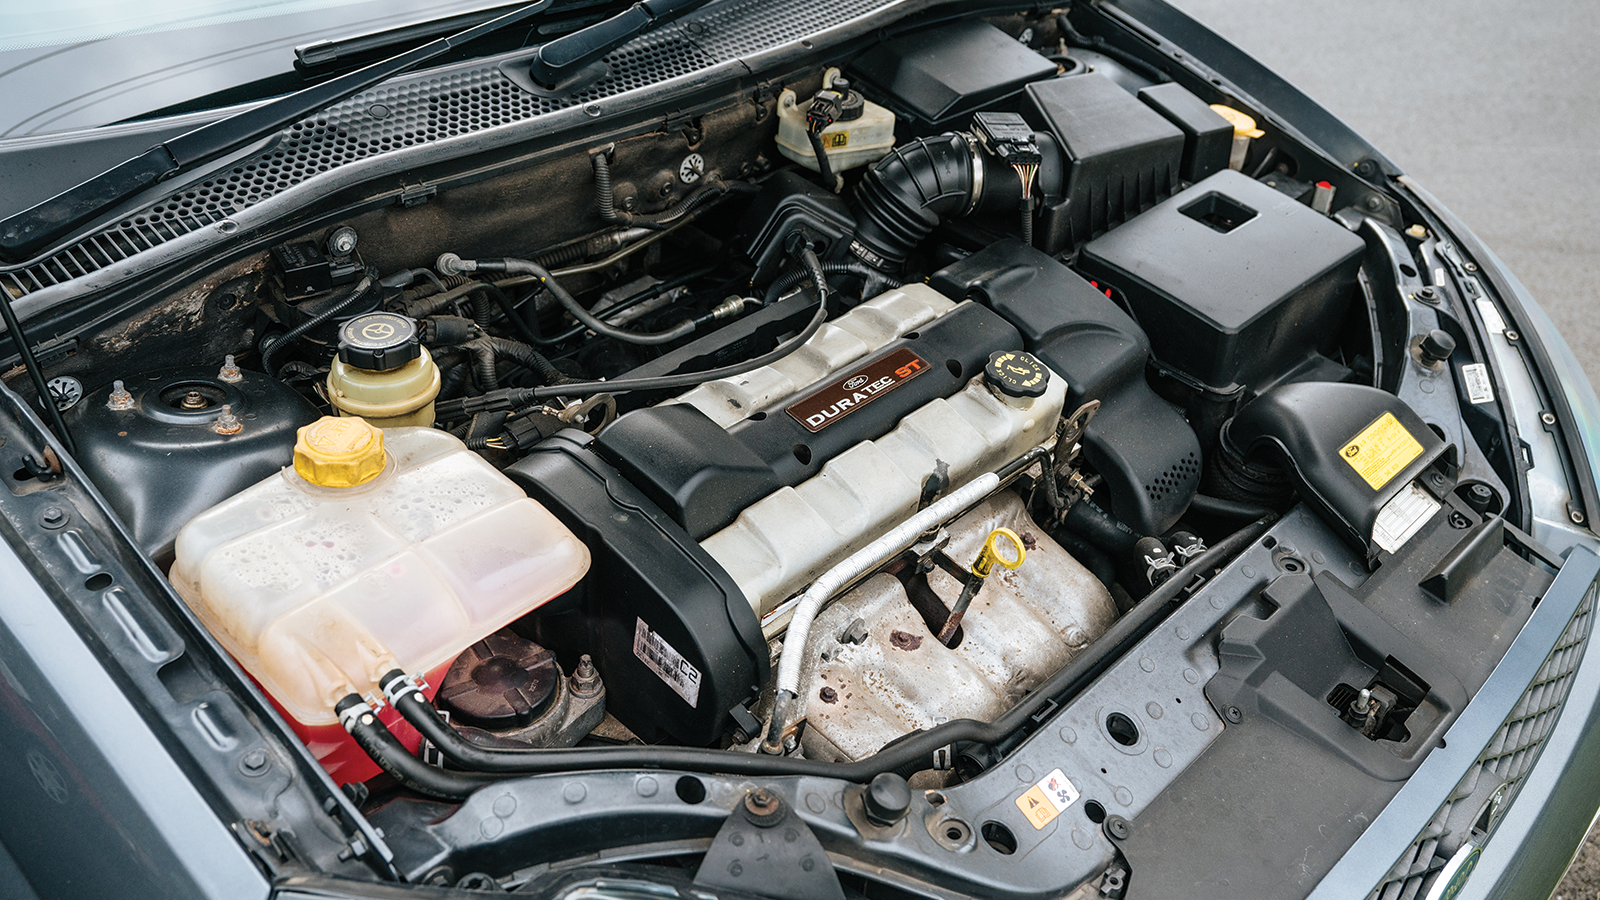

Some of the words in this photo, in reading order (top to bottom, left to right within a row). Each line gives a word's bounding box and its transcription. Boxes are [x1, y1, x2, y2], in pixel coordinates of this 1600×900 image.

[895, 359, 921, 378] ST
[1020, 356, 1041, 371] CLICK
[847, 377, 865, 389] Ford
[996, 369, 1017, 384] CLICK
[680, 659, 698, 685] C2
